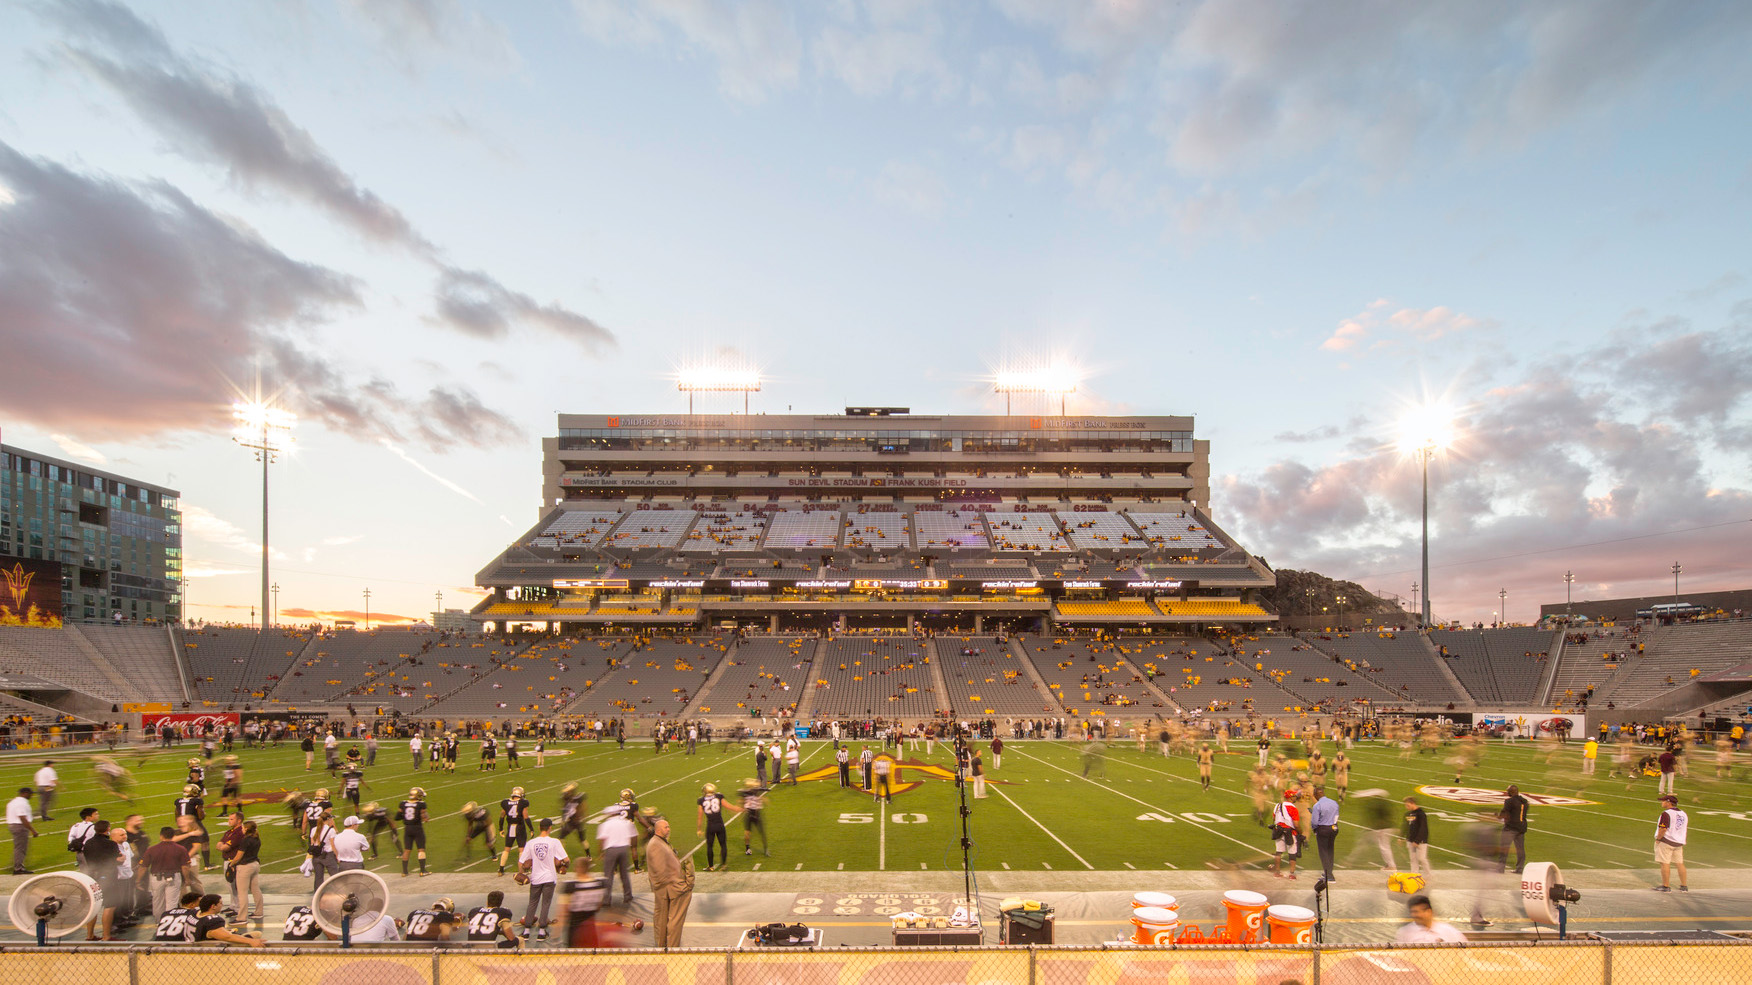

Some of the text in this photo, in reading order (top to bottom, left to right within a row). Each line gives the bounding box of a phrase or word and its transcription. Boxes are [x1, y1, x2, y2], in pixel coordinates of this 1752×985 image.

[663, 417, 686, 426] BANK
[1084, 420, 1107, 428] BANK
[636, 503, 650, 511] 50
[692, 503, 705, 512] 42
[743, 503, 758, 512] 84
[802, 503, 815, 512] 33
[858, 503, 871, 512] 27
[960, 503, 975, 512] 40
[1014, 504, 1028, 512] 52
[1073, 504, 1087, 512] 62
[180, 803, 186, 816] 1
[508, 805, 518, 818] 4
[702, 798, 720, 814] 28
[306, 806, 324, 820] 22
[405, 807, 415, 821] 8
[1521, 881, 1542, 891] BIG
[156, 915, 187, 936] 26
[283, 912, 314, 936] 63
[407, 914, 434, 935] 18
[469, 913, 499, 935] 49
[1247, 913, 1261, 929] G
[1154, 931, 1170, 945] G
[1296, 929, 1310, 945] G
